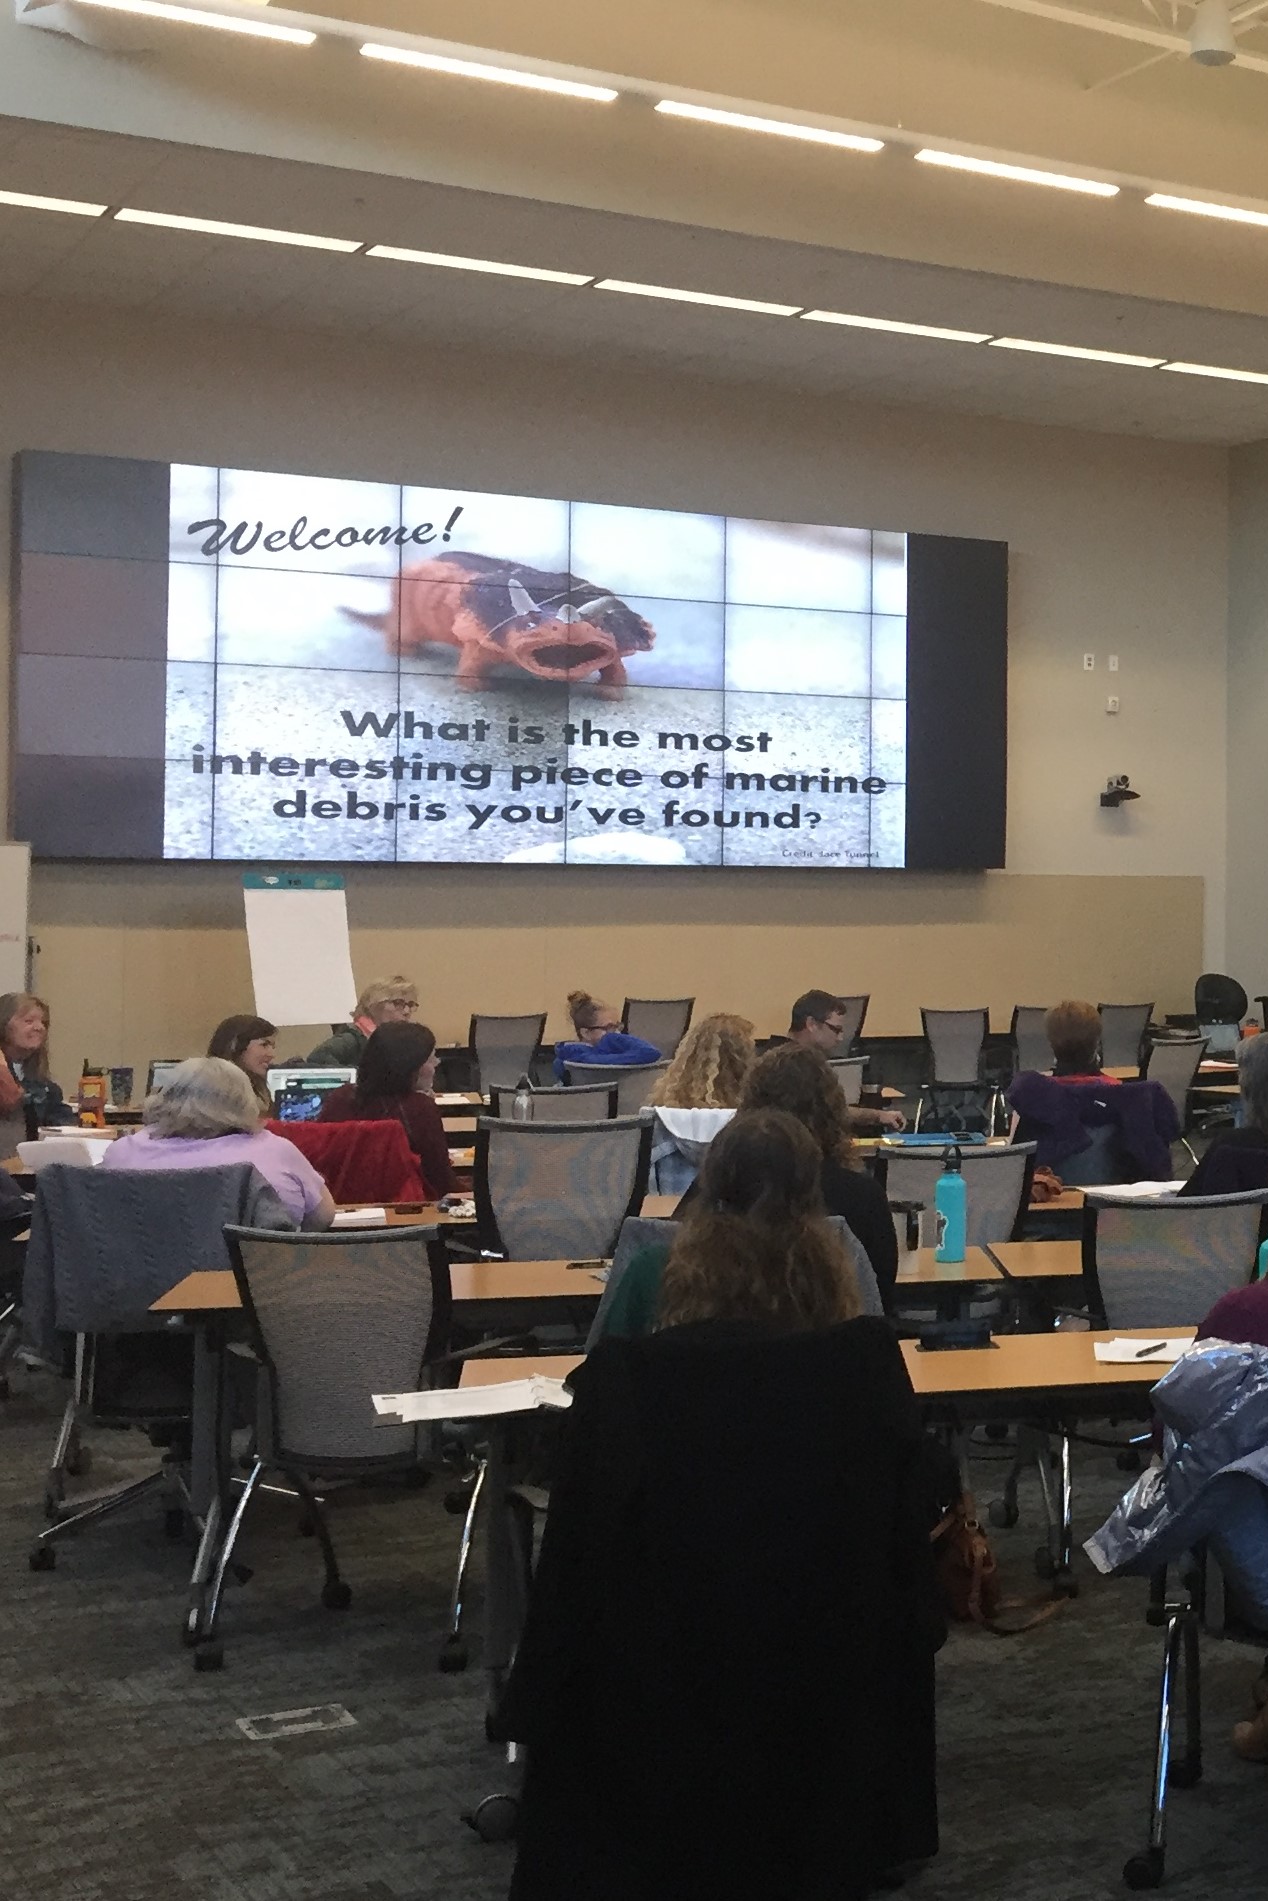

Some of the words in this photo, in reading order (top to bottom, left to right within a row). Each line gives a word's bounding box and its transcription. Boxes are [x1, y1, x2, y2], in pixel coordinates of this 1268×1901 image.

[187, 506, 464, 556] Welcome!
[340, 710, 491, 742] What
[508, 716, 545, 745] is
[562, 719, 640, 748] the
[658, 731, 773, 753] most
[192, 743, 492, 790] interesting
[512, 757, 642, 791] piece
[660, 763, 709, 790] of
[725, 767, 887, 795] marine
[272, 790, 447, 821] debris
[466, 799, 646, 830] you've
[662, 800, 822, 829] found?
